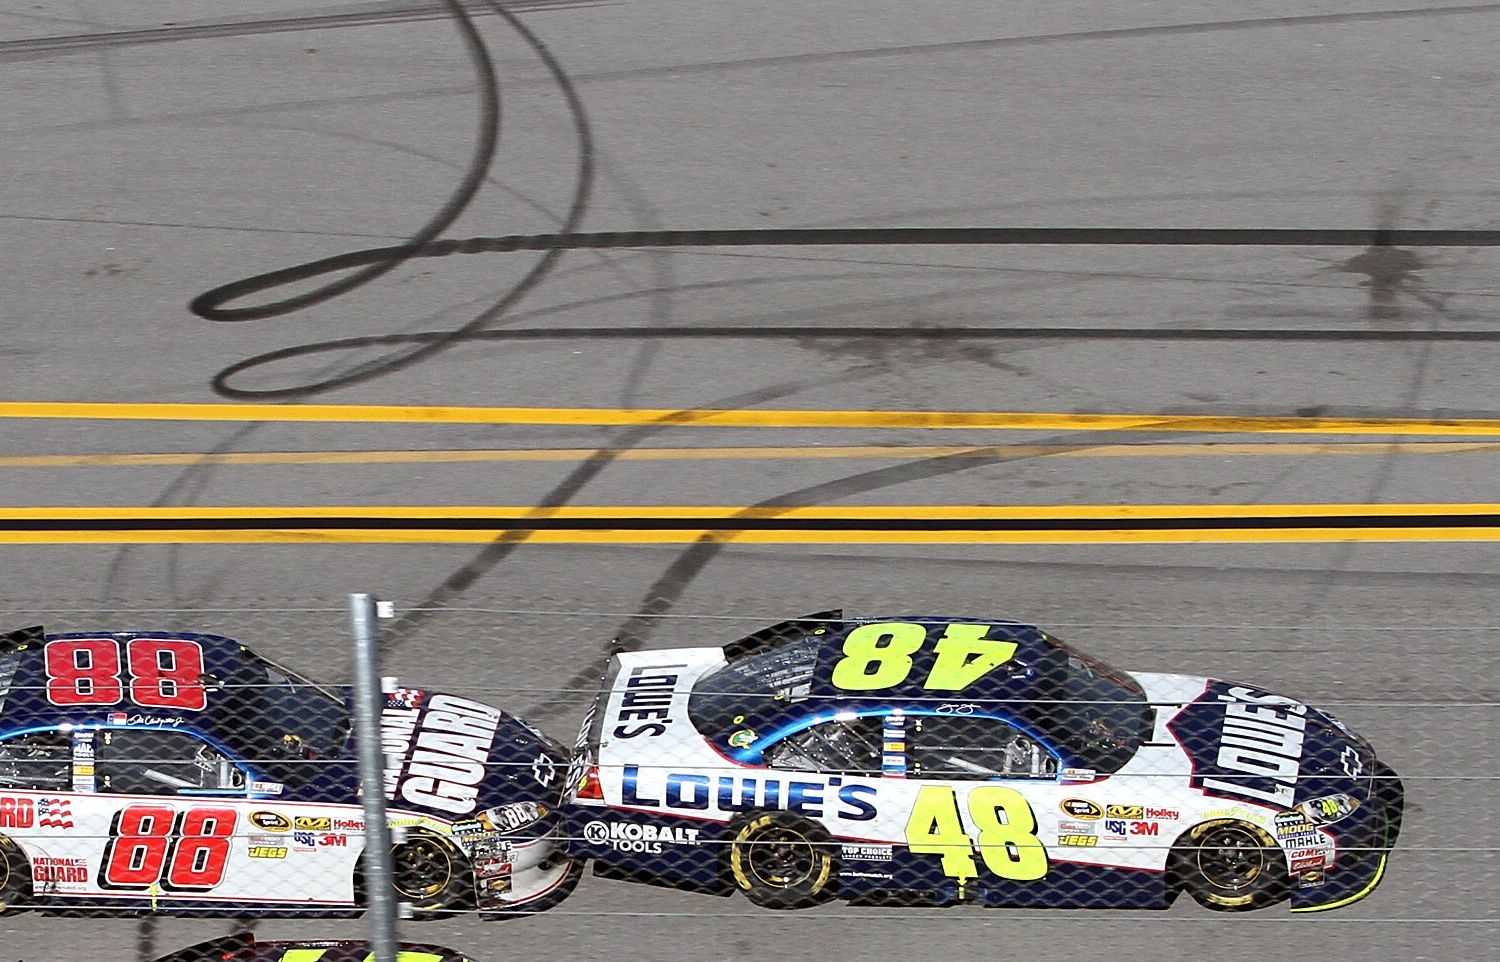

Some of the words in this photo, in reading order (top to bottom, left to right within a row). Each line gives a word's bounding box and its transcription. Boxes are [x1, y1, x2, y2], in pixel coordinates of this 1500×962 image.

[832, 622, 1018, 691] 48
[44, 638, 208, 712] 88
[613, 664, 688, 739] LOWE'S
[401, 694, 501, 815] GUARD
[1202, 686, 1308, 808] LOWE'S
[621, 763, 878, 822] LOWE'S
[1146, 808, 1180, 820] Holley
[1322, 800, 1340, 816] 48
[506, 805, 527, 828] 88
[334, 819, 366, 831] Holley
[610, 822, 697, 843] KOBALT
[904, 784, 1048, 881] 48
[1105, 820, 1126, 836] USG
[1129, 821, 1159, 836] 3M
[1277, 822, 1315, 836] MOOG
[97, 803, 240, 889] 88
[318, 833, 348, 847] 3M
[611, 841, 663, 854] TOOLS
[1058, 835, 1099, 848] JEGS
[1286, 835, 1326, 849] MAHLE
[248, 847, 288, 859] JEGS
[842, 847, 864, 856] TOP
[866, 847, 893, 856] CHOICE
[33, 857, 75, 866] NATIONAL
[34, 866, 88, 882] GUARD
